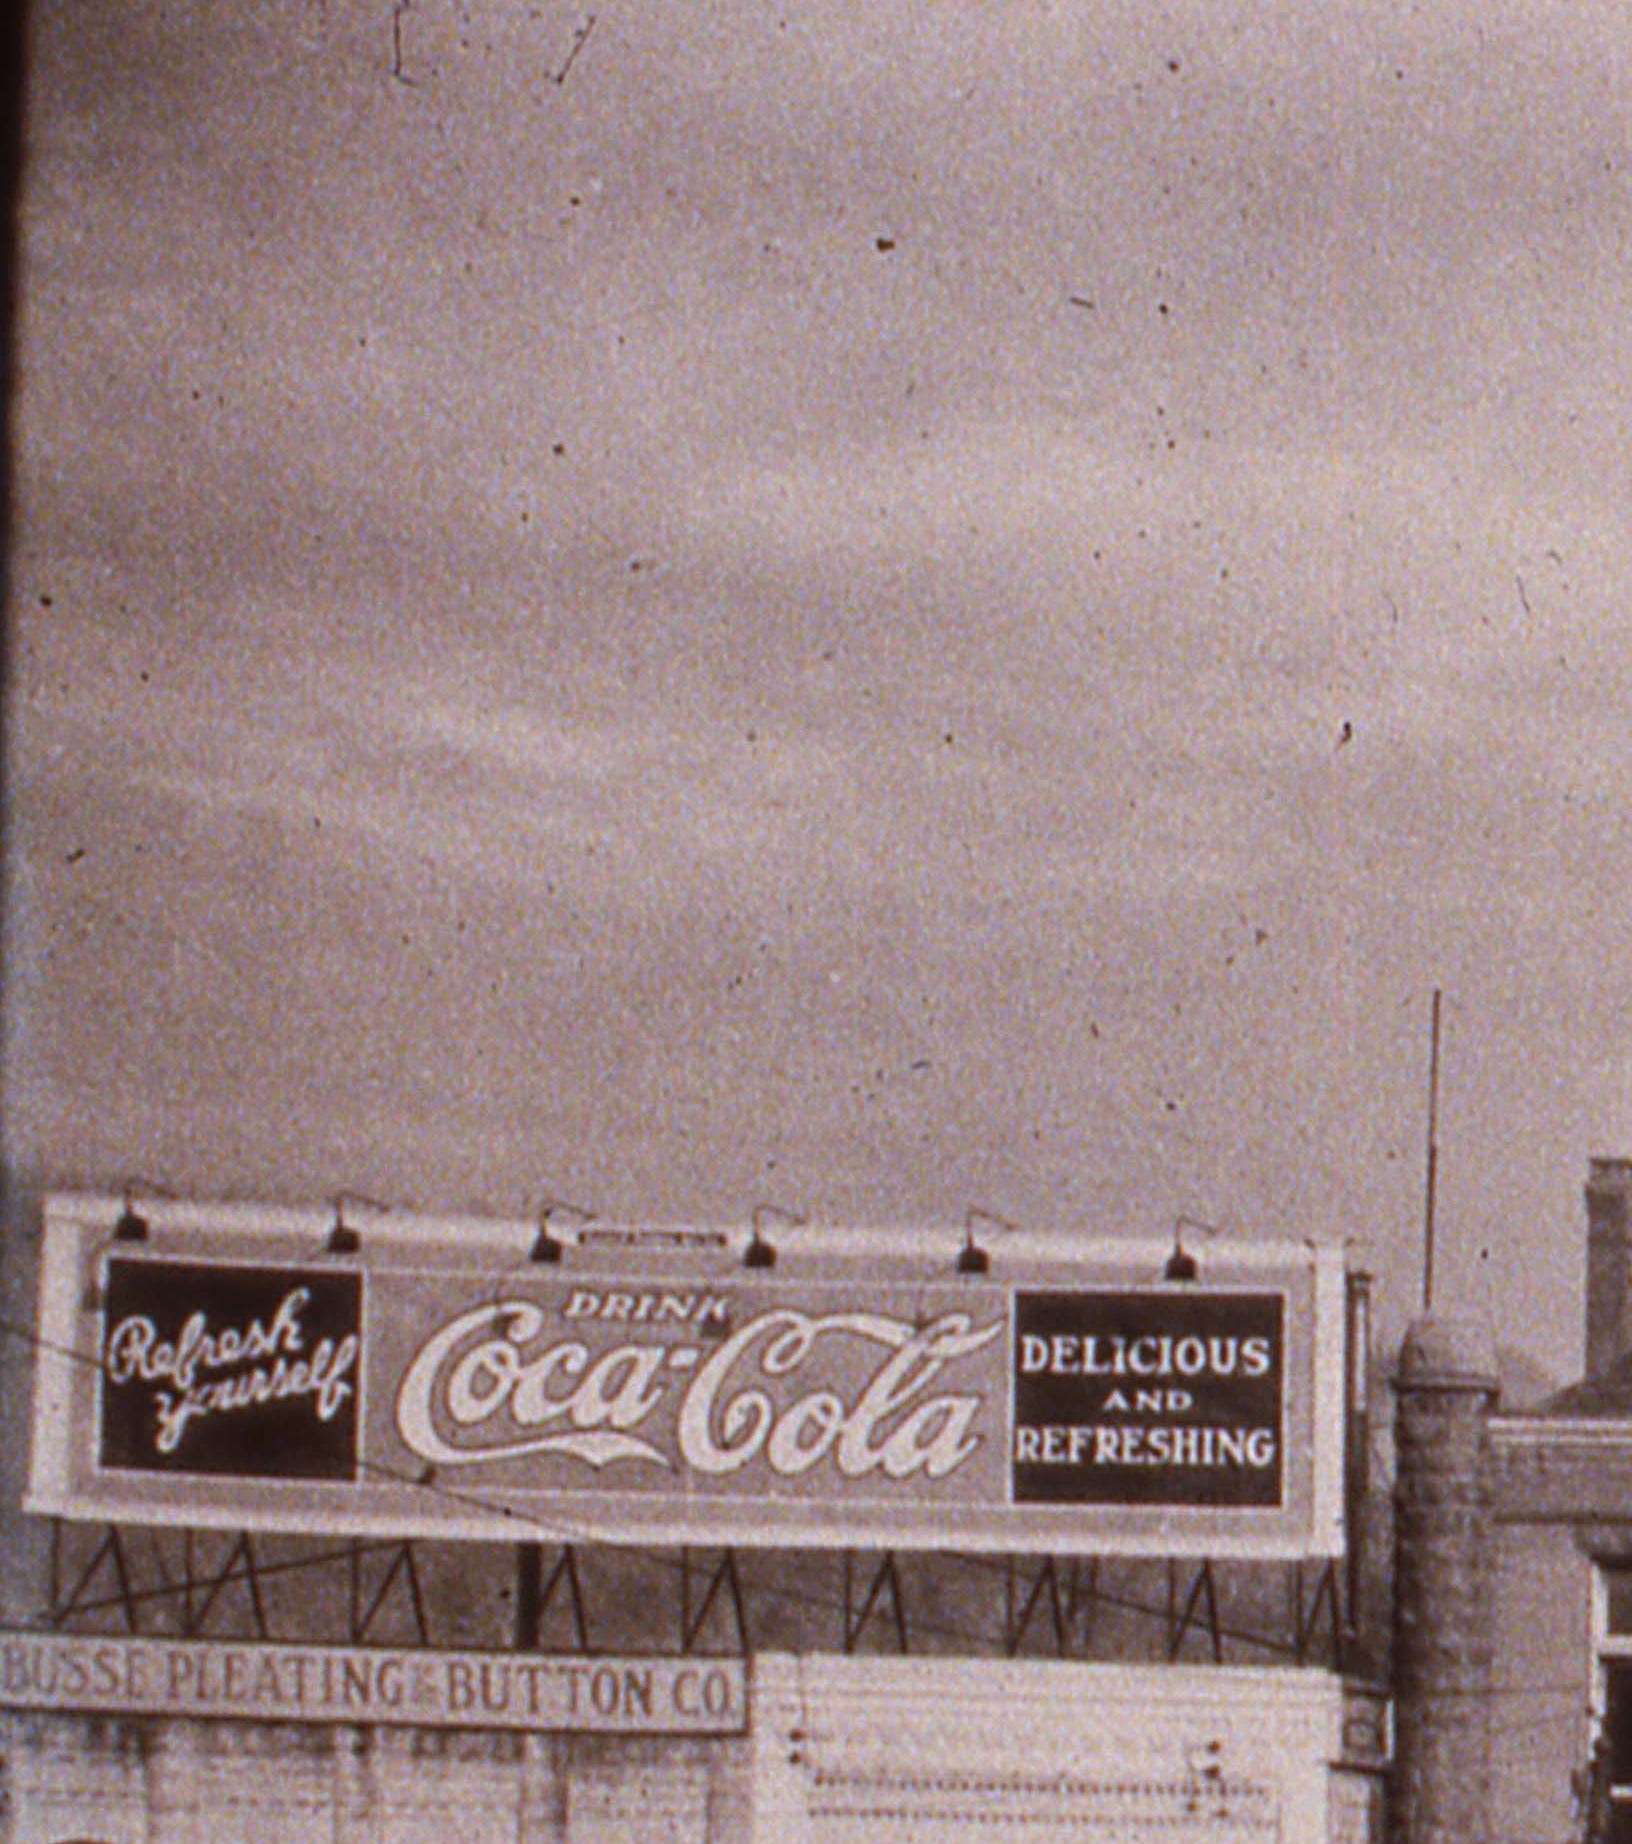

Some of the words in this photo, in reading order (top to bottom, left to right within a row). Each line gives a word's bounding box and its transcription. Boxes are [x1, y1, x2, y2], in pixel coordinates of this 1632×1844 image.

[565, 1292, 727, 1320] DRINK
[108, 1286, 310, 1390] Refresh
[1020, 1334, 1272, 1376] DELICIOUS
[396, 1301, 1003, 1478] Coca-Cola
[1103, 1388, 1193, 1412] AND
[1014, 1424, 1276, 1468] REFRESHING
[166, 1648, 401, 1706] PLEATING
[447, 1659, 655, 1717] BUTTON
